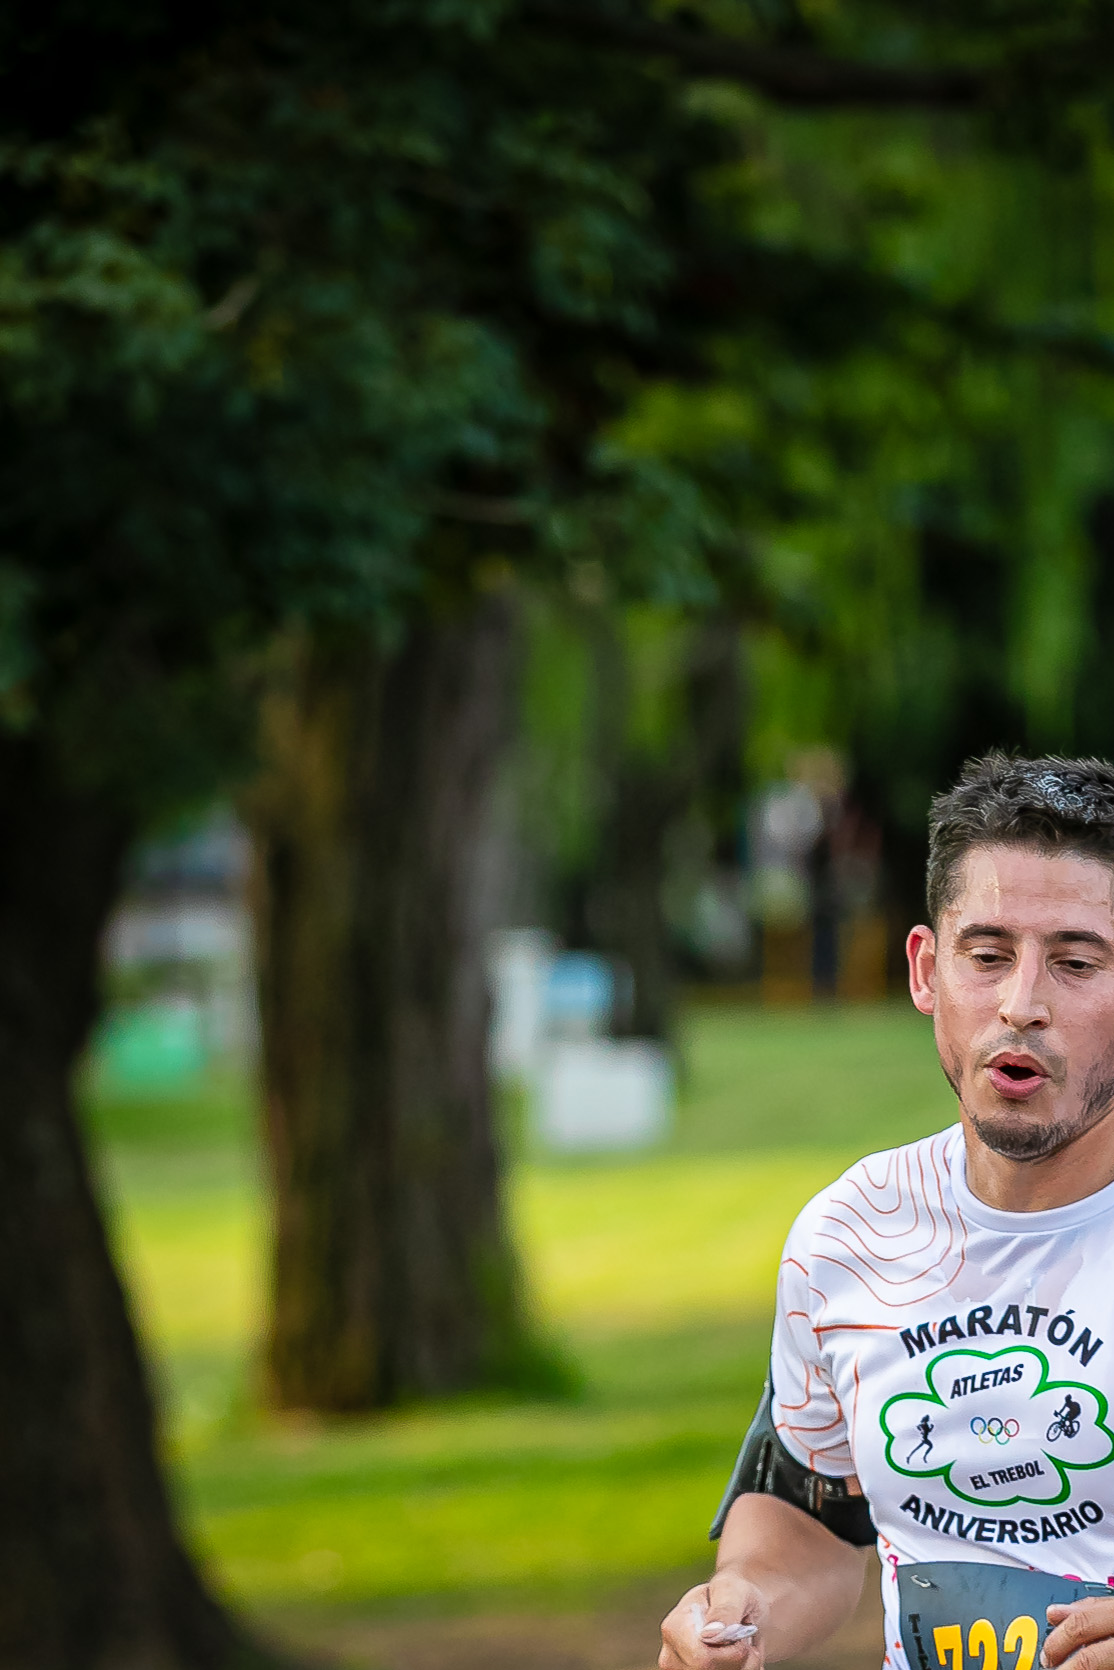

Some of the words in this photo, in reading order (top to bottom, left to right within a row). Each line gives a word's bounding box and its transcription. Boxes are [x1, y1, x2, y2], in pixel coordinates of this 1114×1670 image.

[900, 1304, 1104, 1367] MARATÓN
[950, 1363, 1024, 1399] ATLETAS
[969, 1473, 990, 1490] EL
[992, 1460, 1045, 1486] TREBOL
[900, 1494, 1104, 1544] ANIVERSARIO
